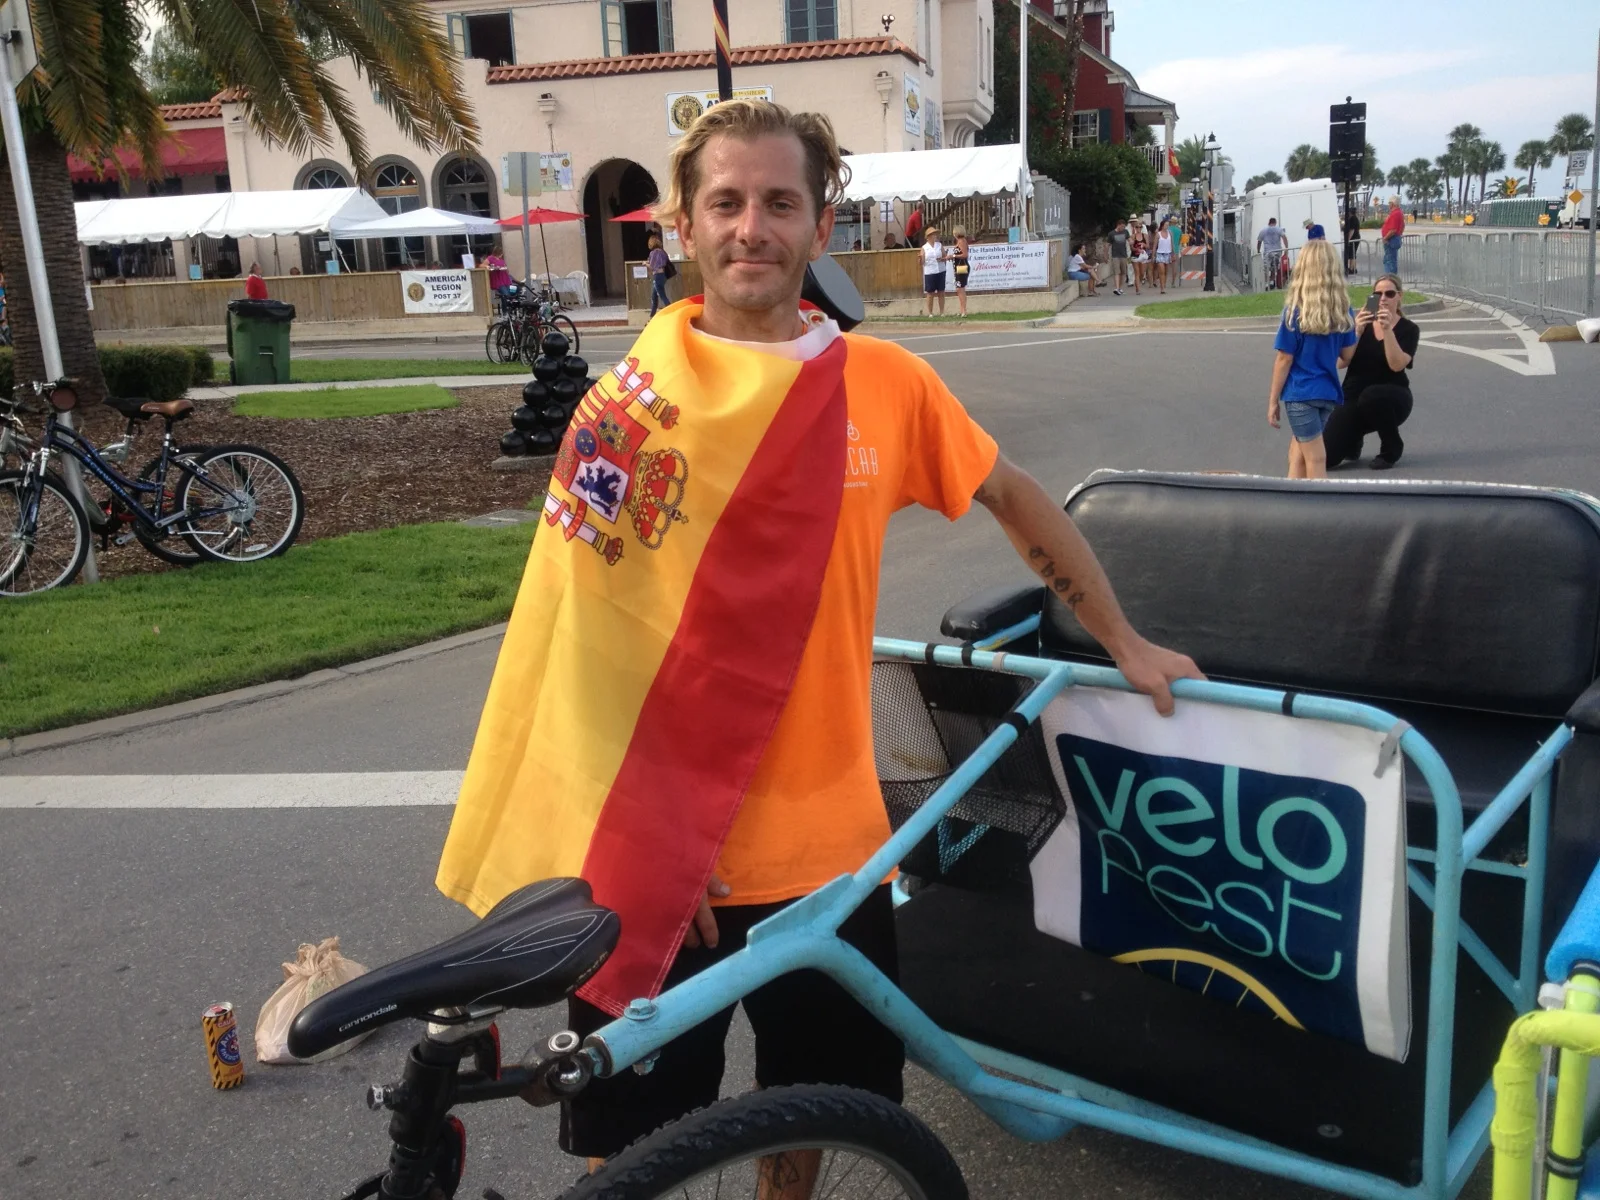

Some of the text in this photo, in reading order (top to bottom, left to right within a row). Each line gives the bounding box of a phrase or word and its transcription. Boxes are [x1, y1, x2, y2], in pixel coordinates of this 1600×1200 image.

[425, 275, 466, 283] AMERICAN
[845, 447, 878, 476] CAB
[1073, 754, 1347, 884] velo
[338, 1003, 398, 1032] cannondale
